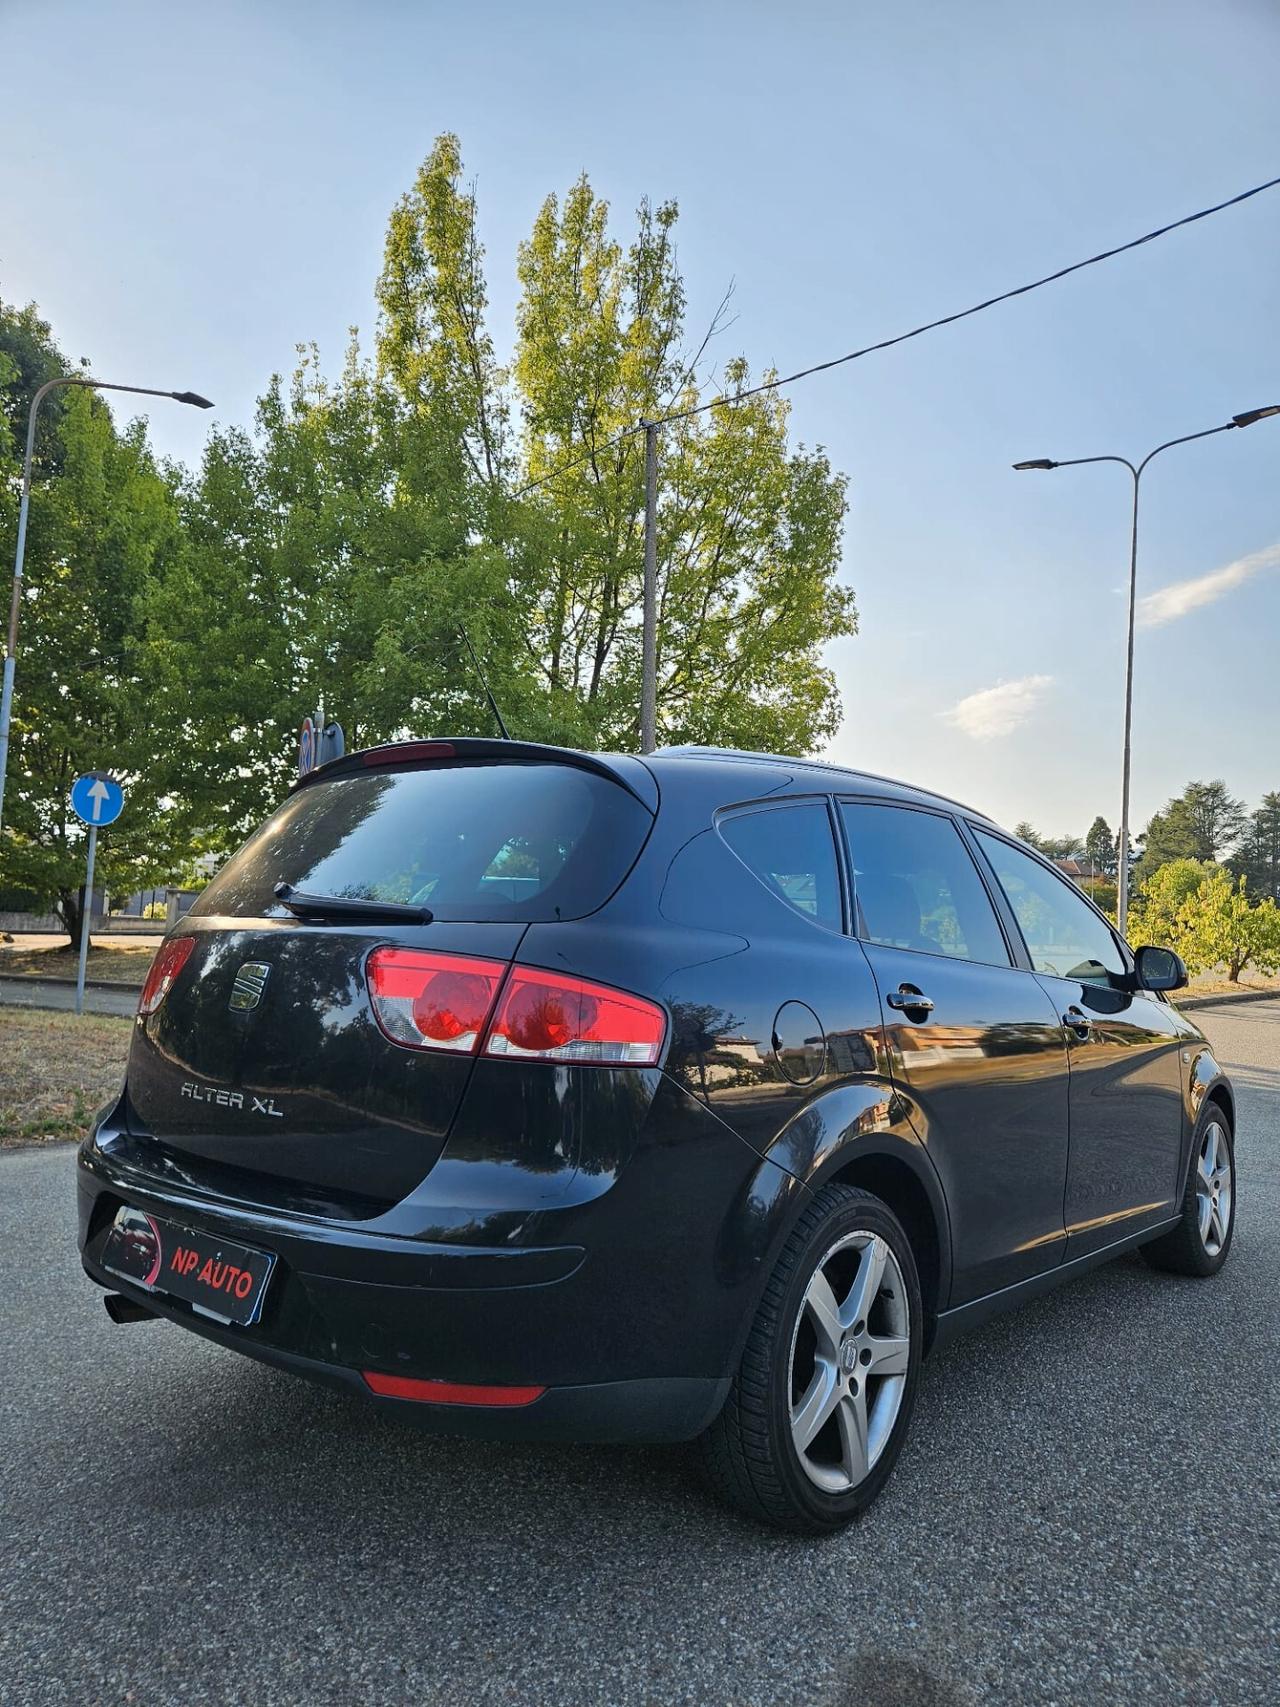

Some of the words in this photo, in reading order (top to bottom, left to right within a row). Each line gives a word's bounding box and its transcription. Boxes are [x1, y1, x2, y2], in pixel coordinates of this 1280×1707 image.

[251, 1096, 284, 1117] XL
[170, 1246, 199, 1276] NP
[197, 1257, 253, 1299] AUTO
